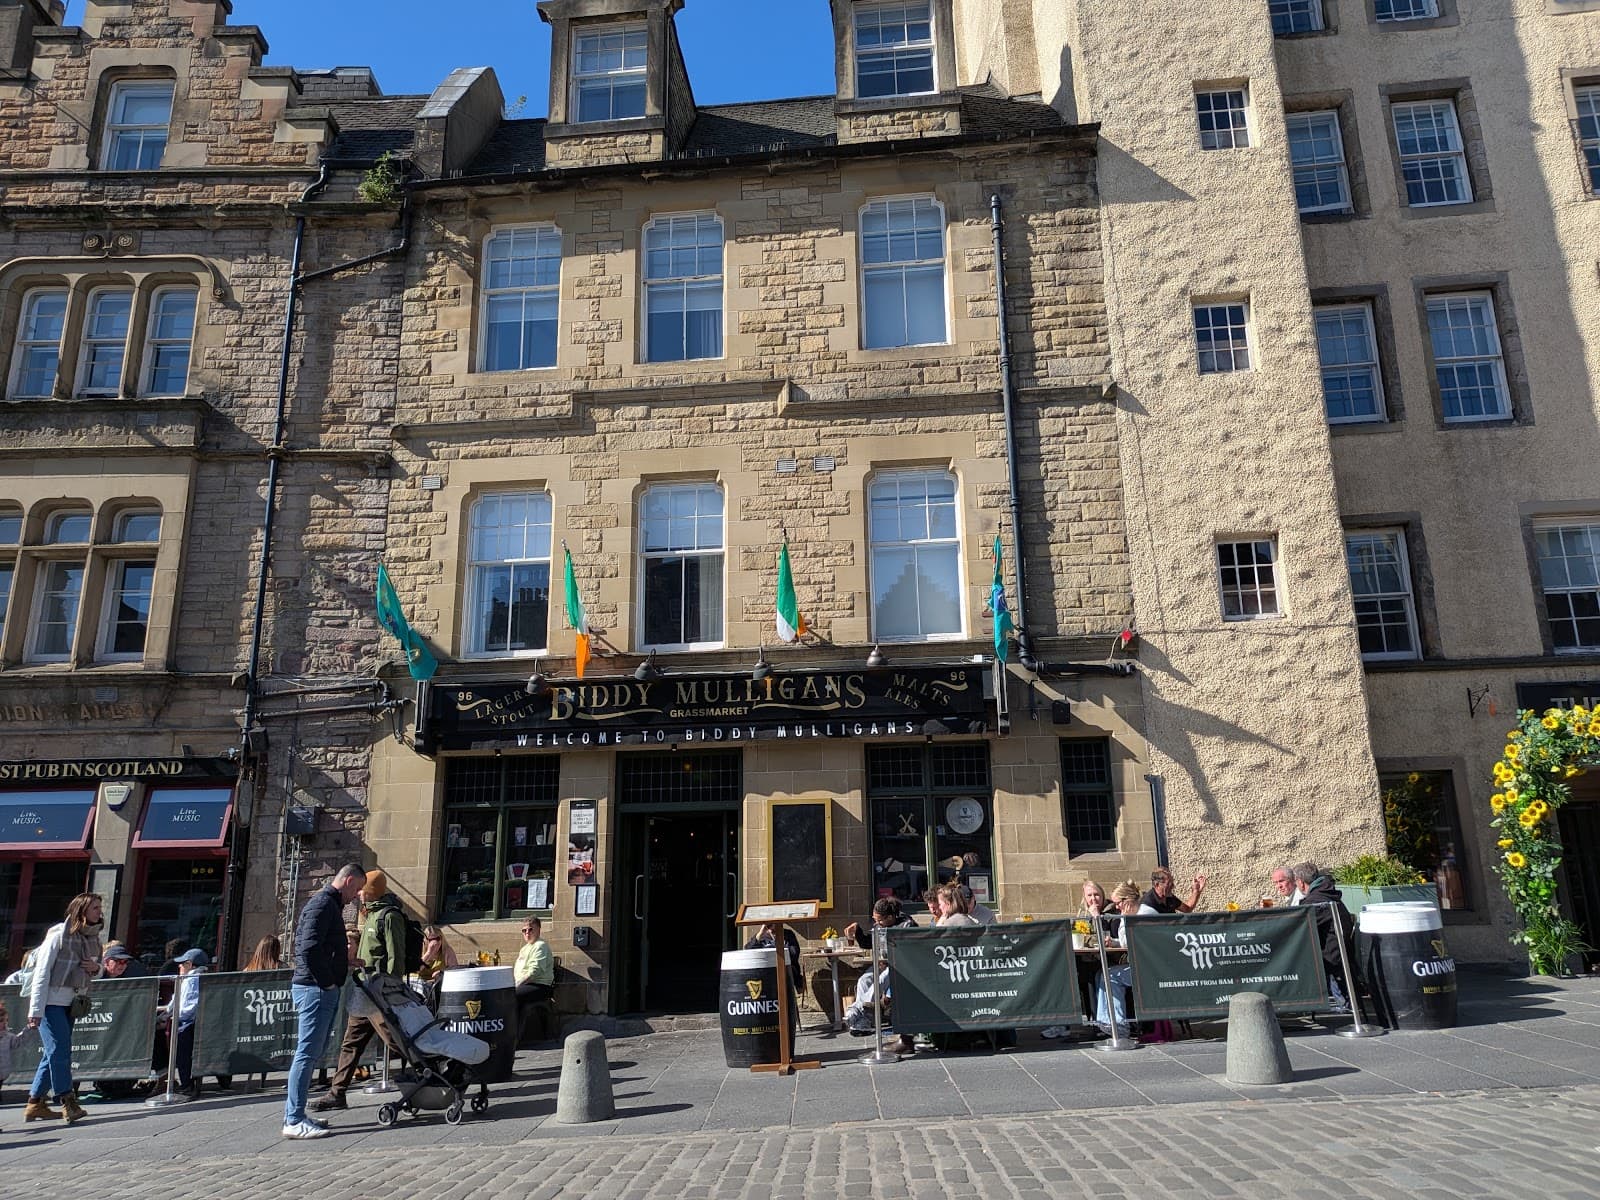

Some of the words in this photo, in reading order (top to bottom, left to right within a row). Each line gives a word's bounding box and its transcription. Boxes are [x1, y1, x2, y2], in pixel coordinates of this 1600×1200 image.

[950, 671, 966, 681] 96
[458, 691, 472, 701] 96
[549, 683, 653, 721] BIDDY
[676, 674, 865, 709] MULLIGANS
[893, 673, 951, 706] MALTS
[884, 688, 920, 709] ALES
[491, 703, 535, 725] STOUT
[669, 707, 748, 718] GRASSMARKET
[517, 731, 622, 747] WELCOME
[641, 729, 665, 742] TO
[685, 726, 756, 741] BIDDY
[777, 721, 913, 738] MULLIGANS
[24, 763, 60, 778] PUB
[62, 762, 84, 777] IN
[84, 761, 183, 777] SCOTLAND
[172, 814, 201, 822] MUSIC
[1175, 932, 1227, 957] BIDDY
[934, 945, 985, 969] BIDDY
[1191, 943, 1272, 970] MULLIGANS
[949, 956, 1028, 983] MULLIGANS
[1159, 980, 1199, 988] BREAKFAST
[951, 992, 969, 1000] FOOD
[727, 999, 779, 1016] GUINNES
[971, 1007, 1000, 1018] JAMESON
[253, 1034, 276, 1042] MUSIC
[270, 1049, 296, 1059] JAMESO
